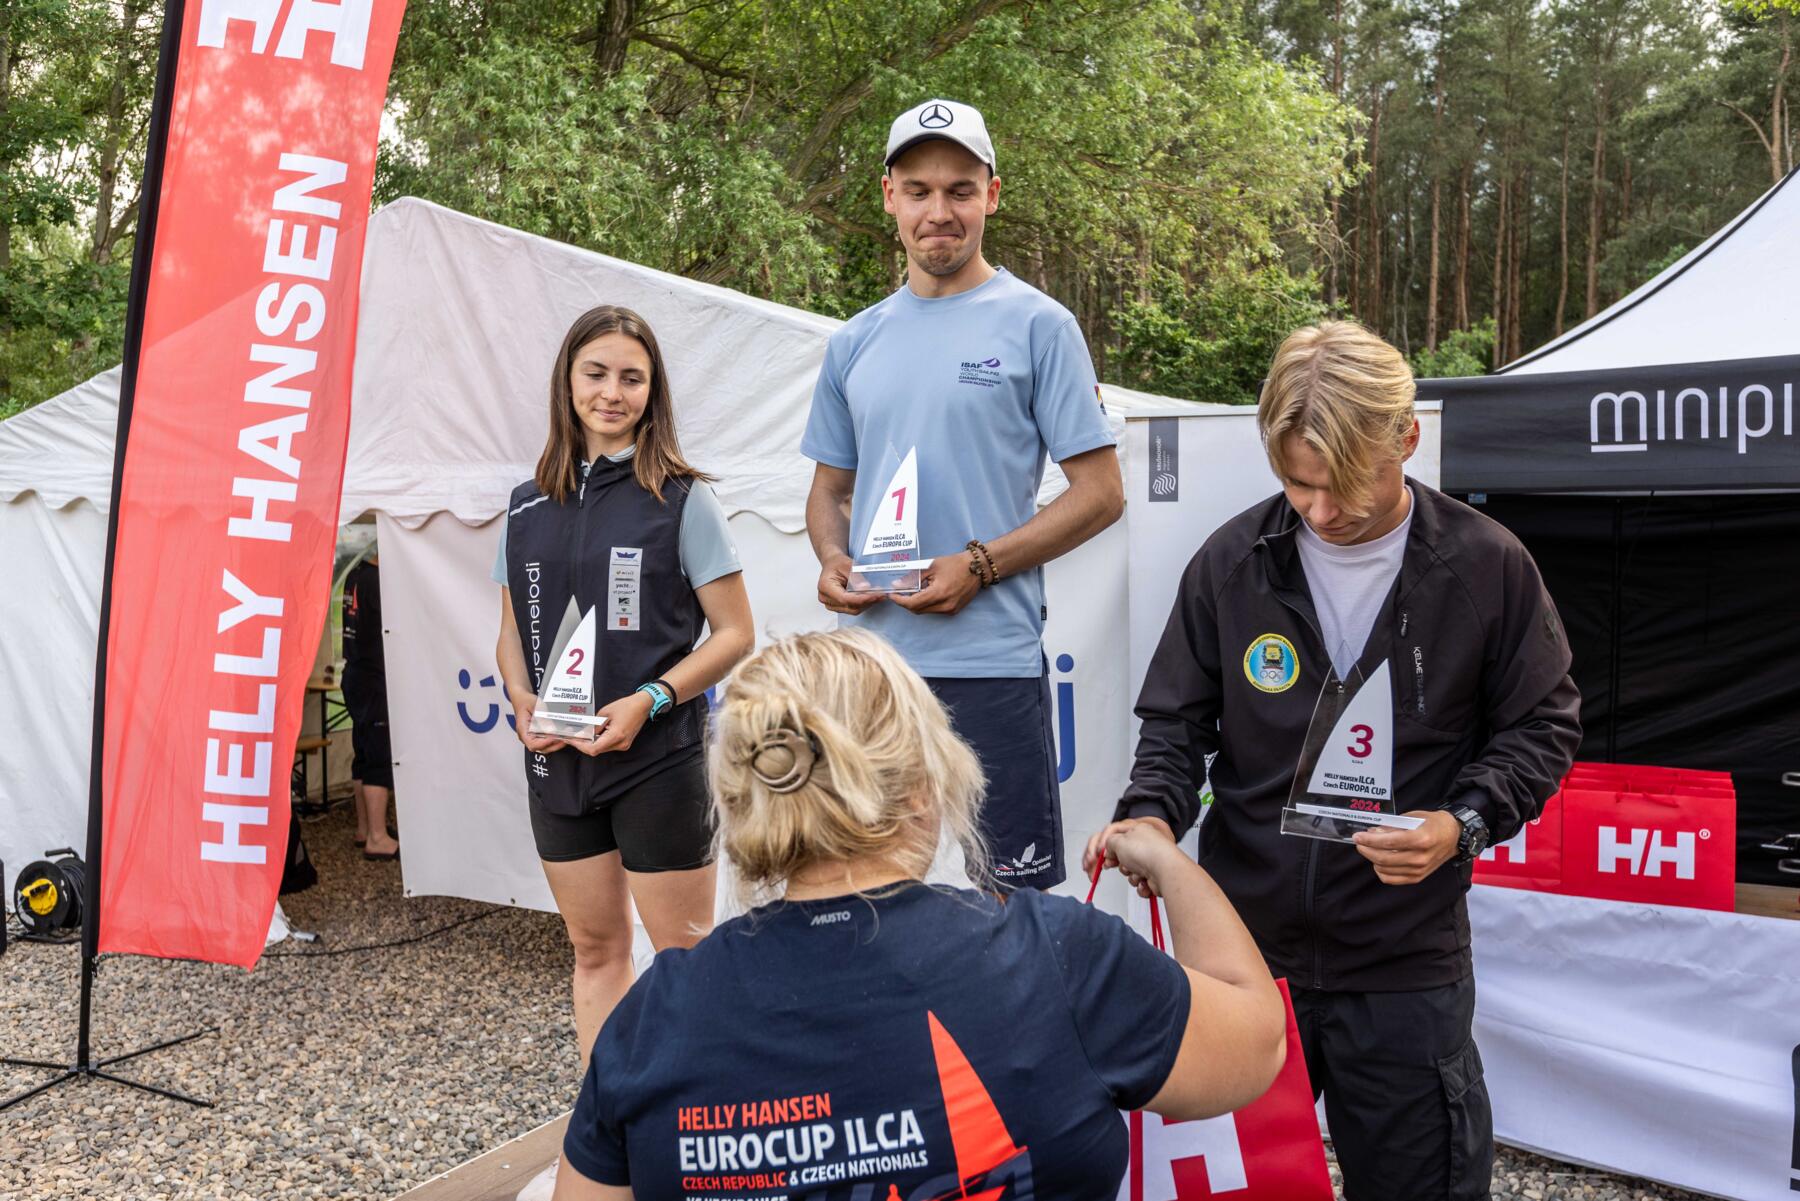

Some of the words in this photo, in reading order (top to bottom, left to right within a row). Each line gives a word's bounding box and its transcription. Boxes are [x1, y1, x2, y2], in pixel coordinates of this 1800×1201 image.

[228, 153, 349, 541] HANSEN
[891, 486, 907, 521] 1
[882, 540, 902, 548] EUROPA
[902, 539, 913, 547] CUP
[566, 648, 585, 676] 2
[200, 568, 284, 865] HELLY
[1346, 724, 1374, 758] 3
[1323, 781, 1339, 789] Czech
[1339, 781, 1370, 794] EUROPA
[1371, 785, 1387, 796] CUP
[1324, 772, 1339, 780] HELLY
[1358, 775, 1375, 785] ILCA
[1349, 799, 1381, 813] 2024
[1016, 867, 1038, 876] sailing
[809, 910, 851, 926] MUSTO
[678, 1104, 738, 1131] HELLY
[742, 1092, 832, 1127] HANSEN
[679, 1123, 835, 1172] EUROCUP
[843, 1109, 925, 1156] ILCA
[682, 1175, 720, 1191] CZECH
[723, 1171, 787, 1191] REPUBLIC
[789, 1171, 799, 1186] &
[801, 1164, 846, 1184] CZECH
[848, 1149, 929, 1178] NATIONALS
